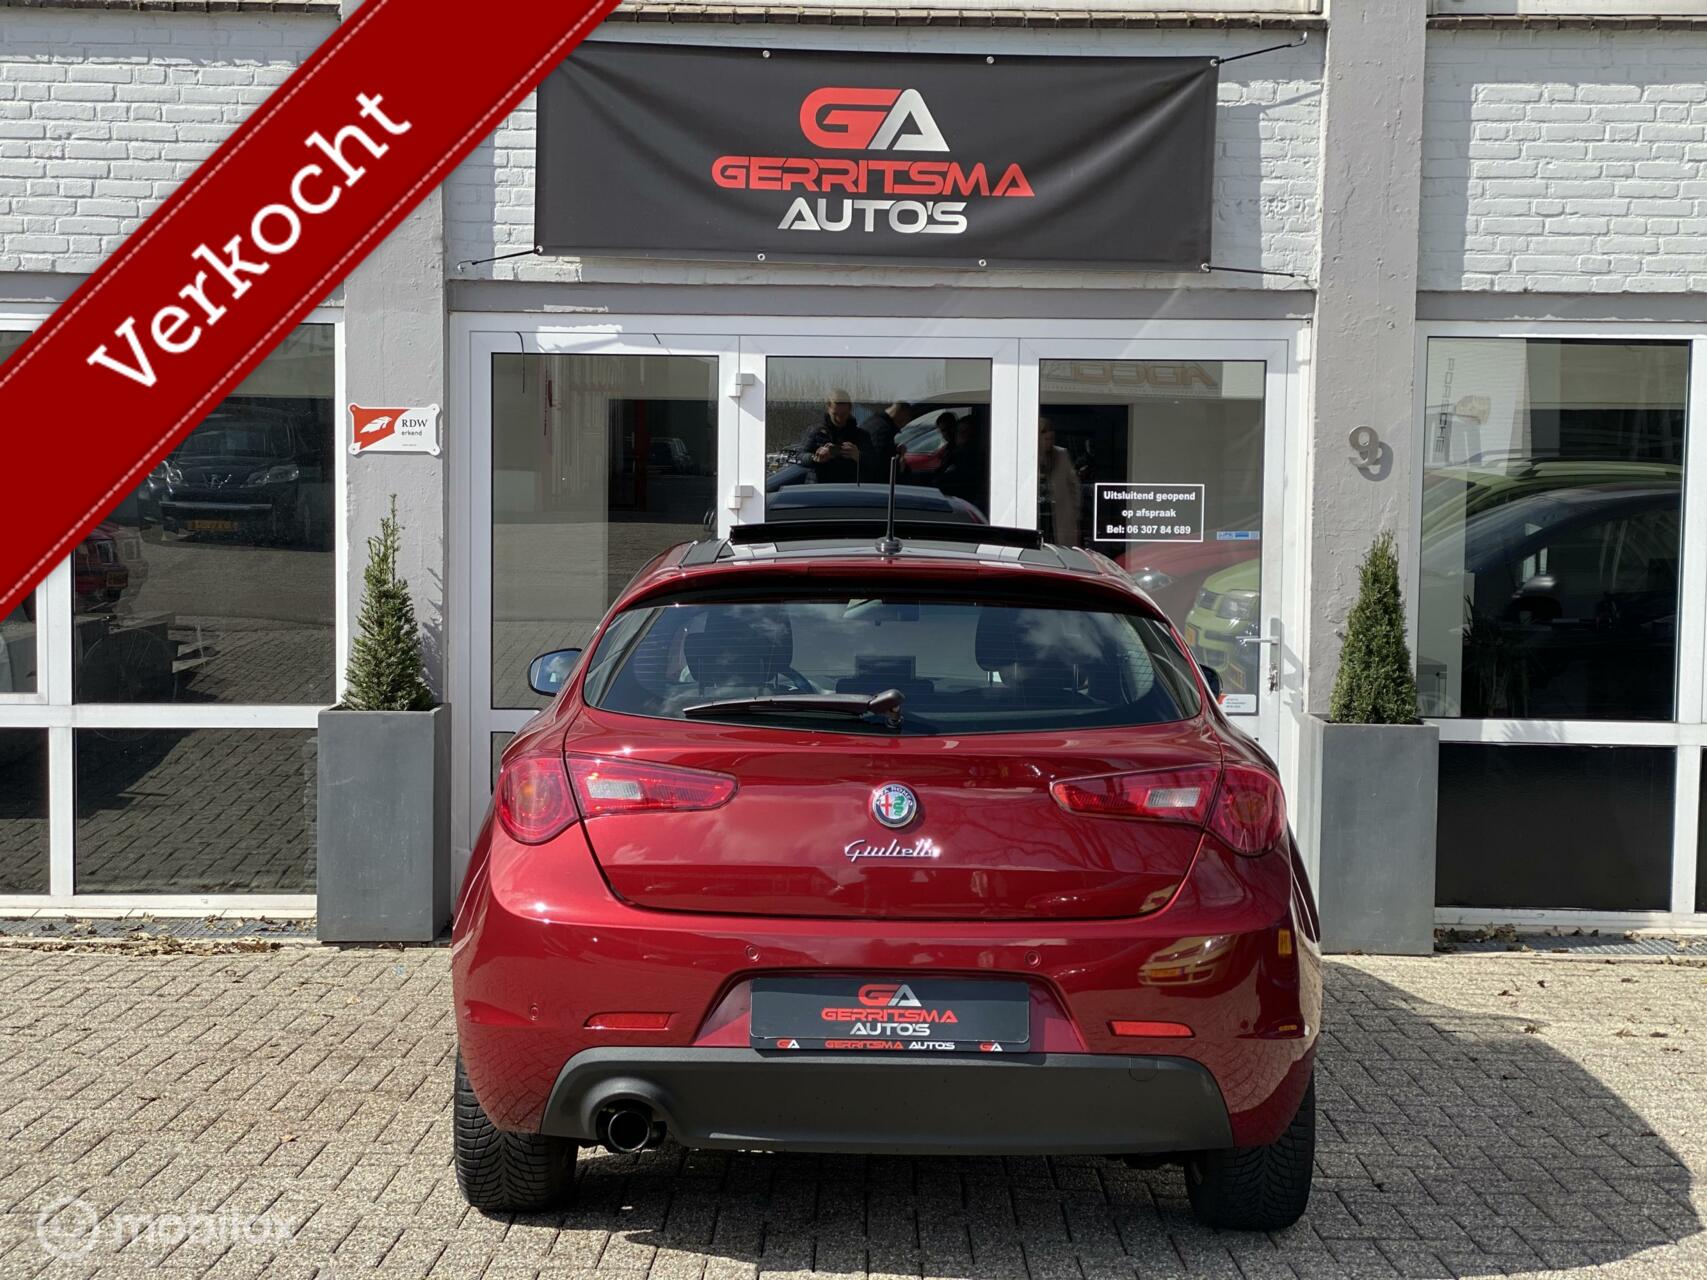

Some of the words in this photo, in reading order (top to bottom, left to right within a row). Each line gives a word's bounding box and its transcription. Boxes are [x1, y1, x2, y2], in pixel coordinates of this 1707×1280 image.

[799, 87, 950, 152] GA
[711, 155, 1036, 197] GERRITSMA
[777, 197, 968, 234] AUTO'S
[401, 419, 427, 428] RDW
[1348, 425, 1379, 468] 9
[1103, 491, 1154, 500] Uitsluitend
[1156, 492, 1196, 502] geopend
[1121, 509, 1134, 518] op
[1136, 508, 1177, 519] afspraak
[1106, 525, 1125, 534] Bel:
[1126, 525, 1139, 534] 06
[1141, 525, 1158, 534] 307
[1160, 525, 1172, 534] 84
[1173, 525, 1191, 535] 689
[858, 984, 922, 1007] GA
[821, 1008, 958, 1023] GERRITSMA
[850, 1022, 931, 1037] AUTO'S
[776, 1038, 800, 1049] GA
[825, 1040, 904, 1050] GERRITSMA
[908, 1041, 956, 1050] AUTO'S
